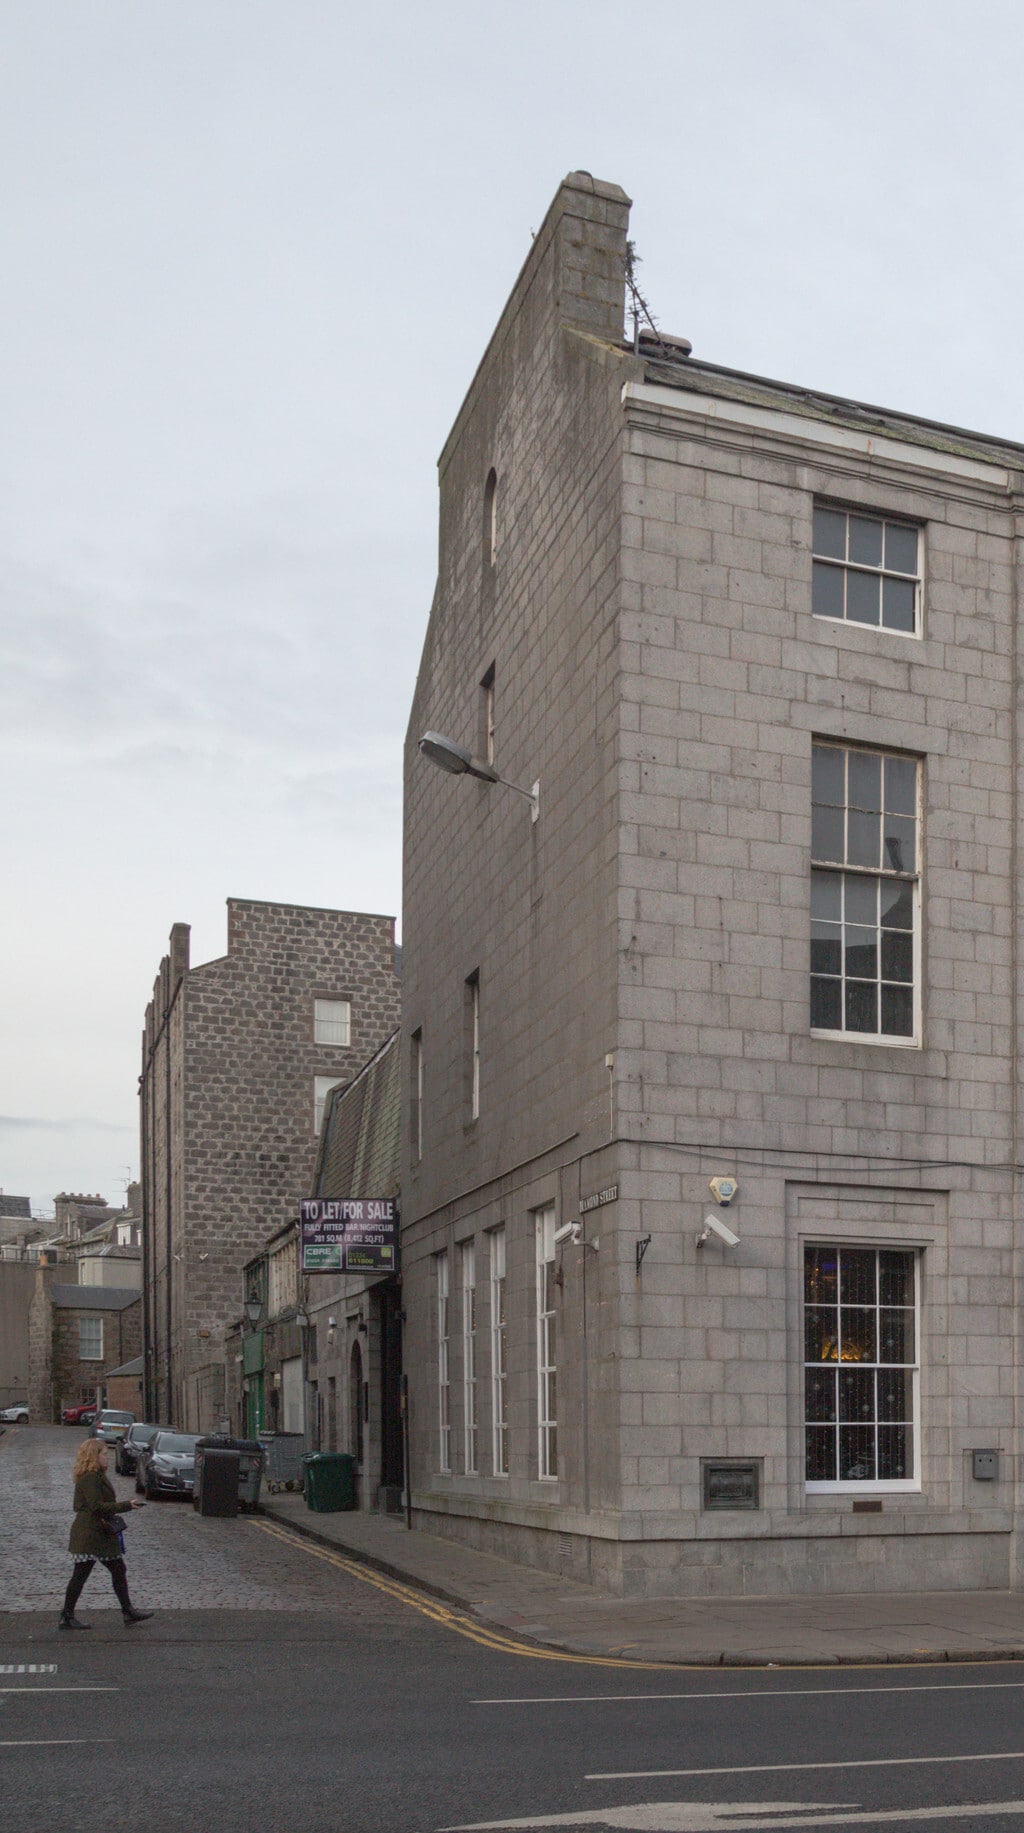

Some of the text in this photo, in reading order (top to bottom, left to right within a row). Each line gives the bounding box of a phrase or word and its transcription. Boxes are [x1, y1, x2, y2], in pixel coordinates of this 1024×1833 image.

[600, 1186, 617, 1205] STREET
[304, 1201, 319, 1220] TO
[367, 1202, 394, 1220] SALE
[304, 1223, 322, 1232] FULLY
[323, 1223, 344, 1232] FITTED
